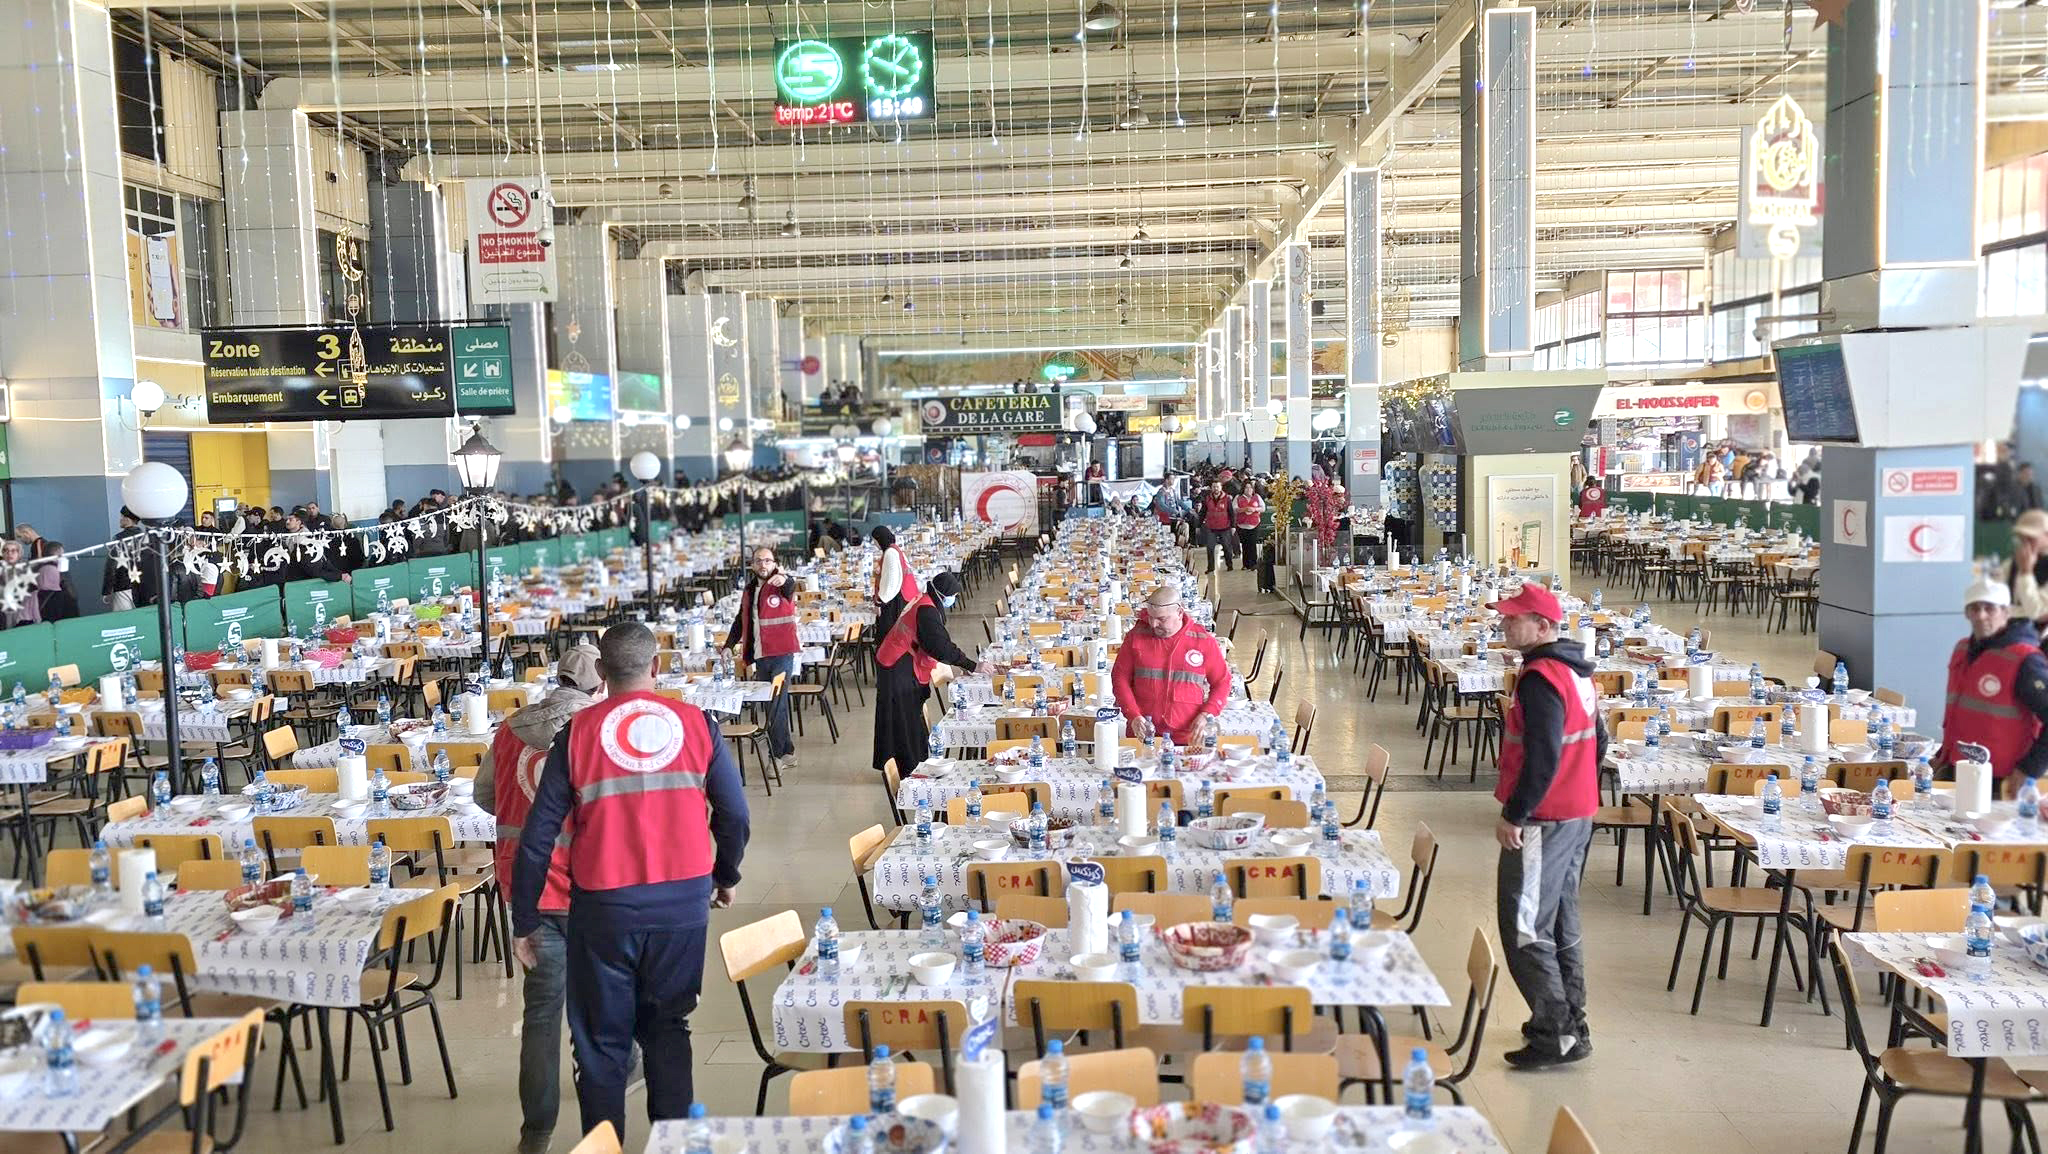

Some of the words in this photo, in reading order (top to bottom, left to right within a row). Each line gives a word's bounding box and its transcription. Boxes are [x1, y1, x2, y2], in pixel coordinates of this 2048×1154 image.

[483, 238, 495, 246] NO
[209, 341, 261, 358] Zone
[316, 334, 341, 360] 3
[389, 337, 444, 353] منطقة
[465, 338, 499, 353] مصلى
[249, 367, 270, 377] toutes
[271, 366, 306, 376] destination
[212, 391, 284, 405] Embarquement
[460, 388, 478, 397] Salle
[478, 388, 488, 396] de
[488, 387, 510, 397] prière
[950, 395, 1051, 411] CAFETERIA
[958, 413, 977, 424] DE
[980, 412, 1000, 424] LA
[1003, 411, 1045, 423] GARE
[1077, 719, 1090, 728] CR
[607, 743, 635, 768] Algerian
[638, 760, 654, 769] Red
[1735, 768, 1766, 779] CRA
[1854, 768, 1883, 777] CRA
[1761, 842, 1772, 866] Cotex
[1781, 843, 1791, 866] Cotex
[1882, 851, 1921, 865] CRA
[1986, 851, 2027, 865] CRA
[883, 863, 892, 886] Cotex
[900, 863, 909, 887] Cotex
[935, 863, 944, 886] Cotex
[998, 876, 1034, 889] CRA
[1248, 866, 1294, 879] CRA
[338, 938, 348, 966] Cotex
[356, 940, 368, 967] Cotex
[287, 970, 296, 998] Cotex
[306, 971, 317, 1000] Cotex
[326, 973, 335, 1001] Cotex
[342, 975, 351, 1003] Cotex
[883, 1009, 929, 1025] CRA
[777, 1016, 789, 1048] Cotex
[799, 1016, 810, 1048] Cotex
[821, 1016, 833, 1048] Cotex
[1951, 1020, 1964, 1052] Cotex
[1976, 1019, 1990, 1052] Cotex
[2002, 1019, 2017, 1051] Cotex
[2027, 1017, 2040, 1051] Cotex
